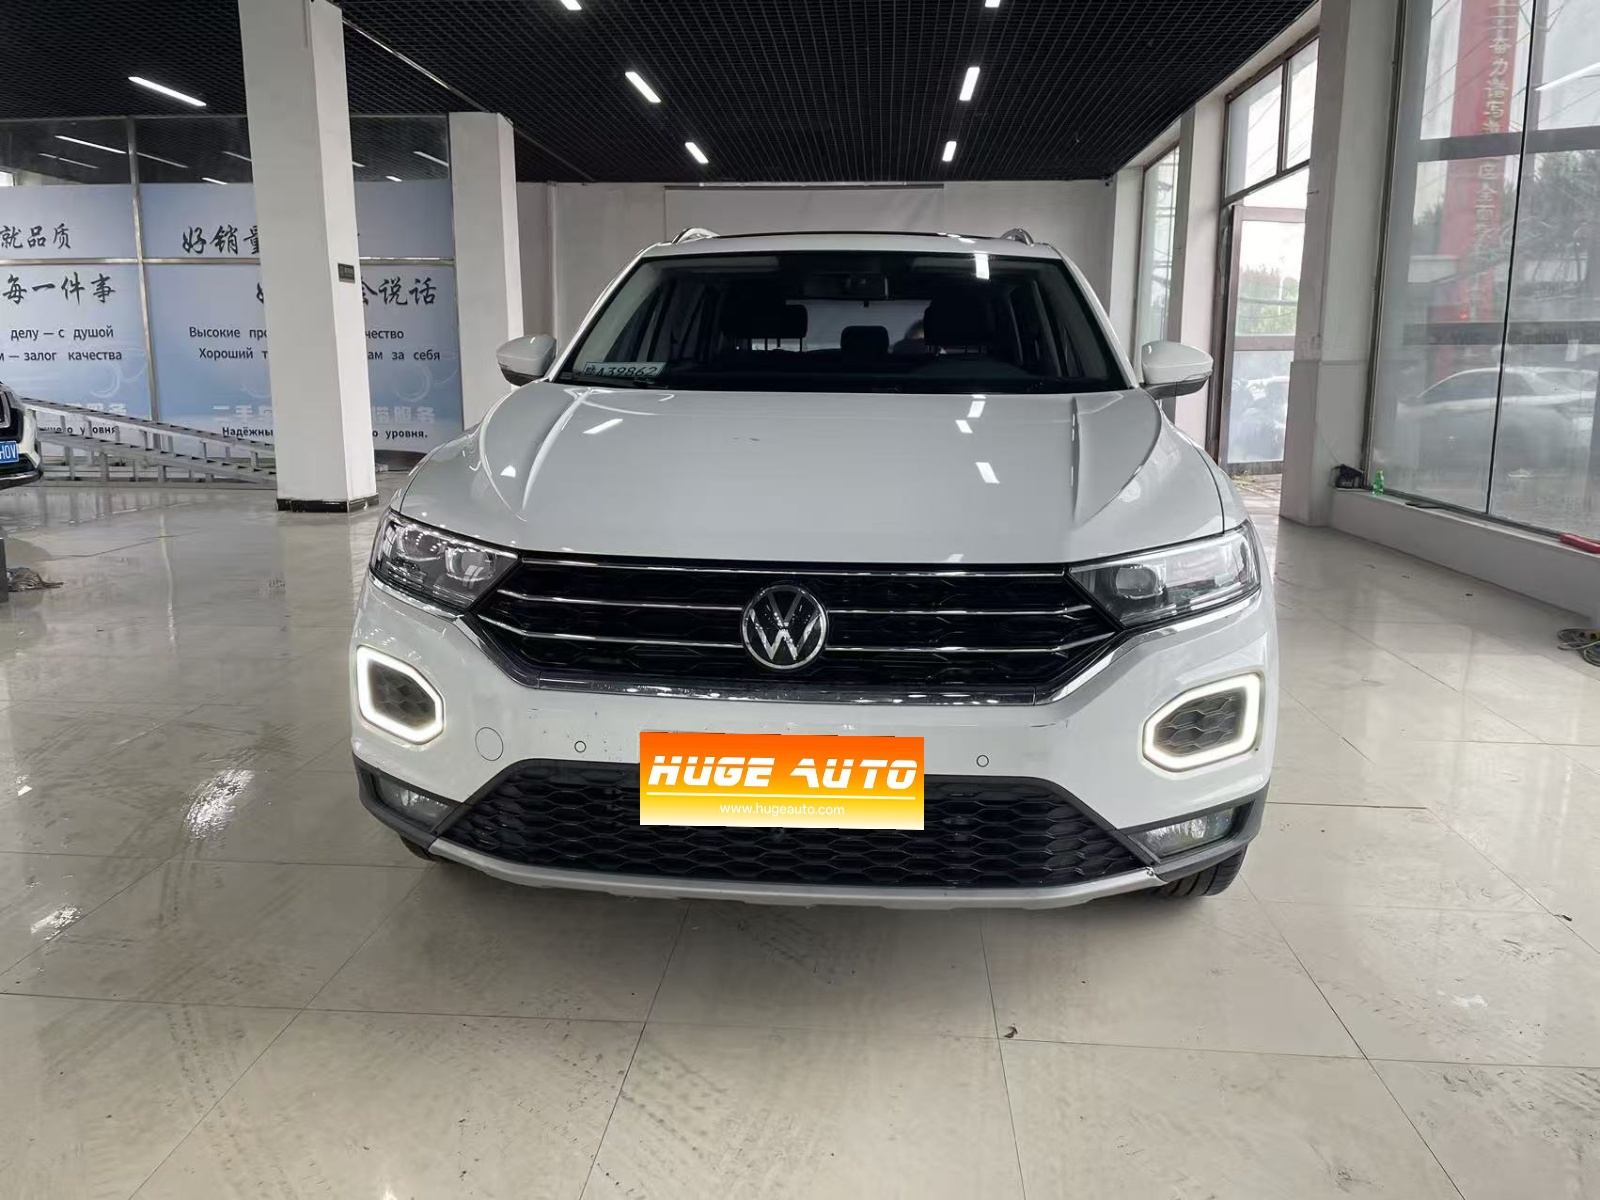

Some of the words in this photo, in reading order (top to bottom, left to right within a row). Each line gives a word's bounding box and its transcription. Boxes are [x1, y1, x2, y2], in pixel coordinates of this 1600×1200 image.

[2, 272, 116, 305] 每一件事
[10, 328, 39, 341] делу
[73, 325, 114, 340] душой
[189, 326, 241, 338] Высокие
[24, 352, 57, 361] залог
[68, 351, 122, 361] качества
[199, 347, 253, 361] Хороший
[392, 352, 405, 361] за
[413, 350, 440, 362] себя
